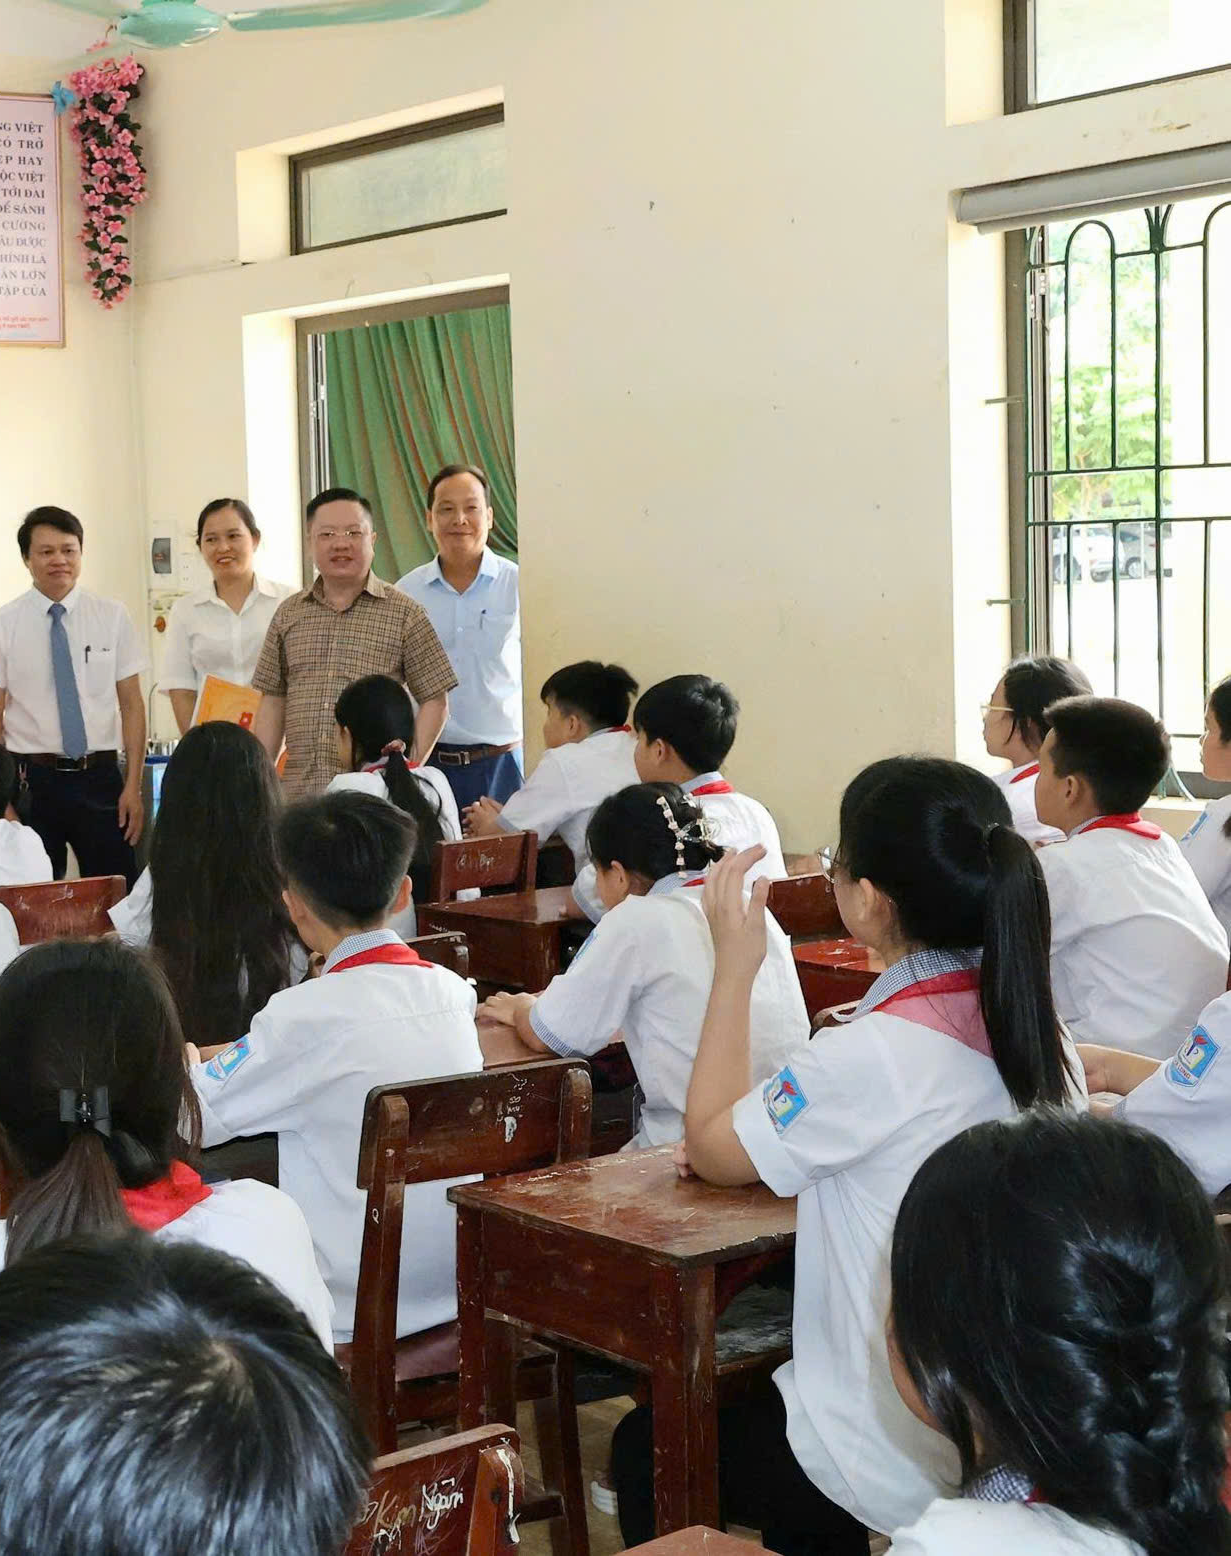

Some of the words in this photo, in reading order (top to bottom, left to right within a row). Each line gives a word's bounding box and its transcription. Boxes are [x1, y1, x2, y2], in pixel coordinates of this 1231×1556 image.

[15, 121, 44, 134] VIỆT
[18, 156, 43, 166] HAY
[18, 171, 44, 183] VIỆT
[13, 204, 45, 215] SÁNH
